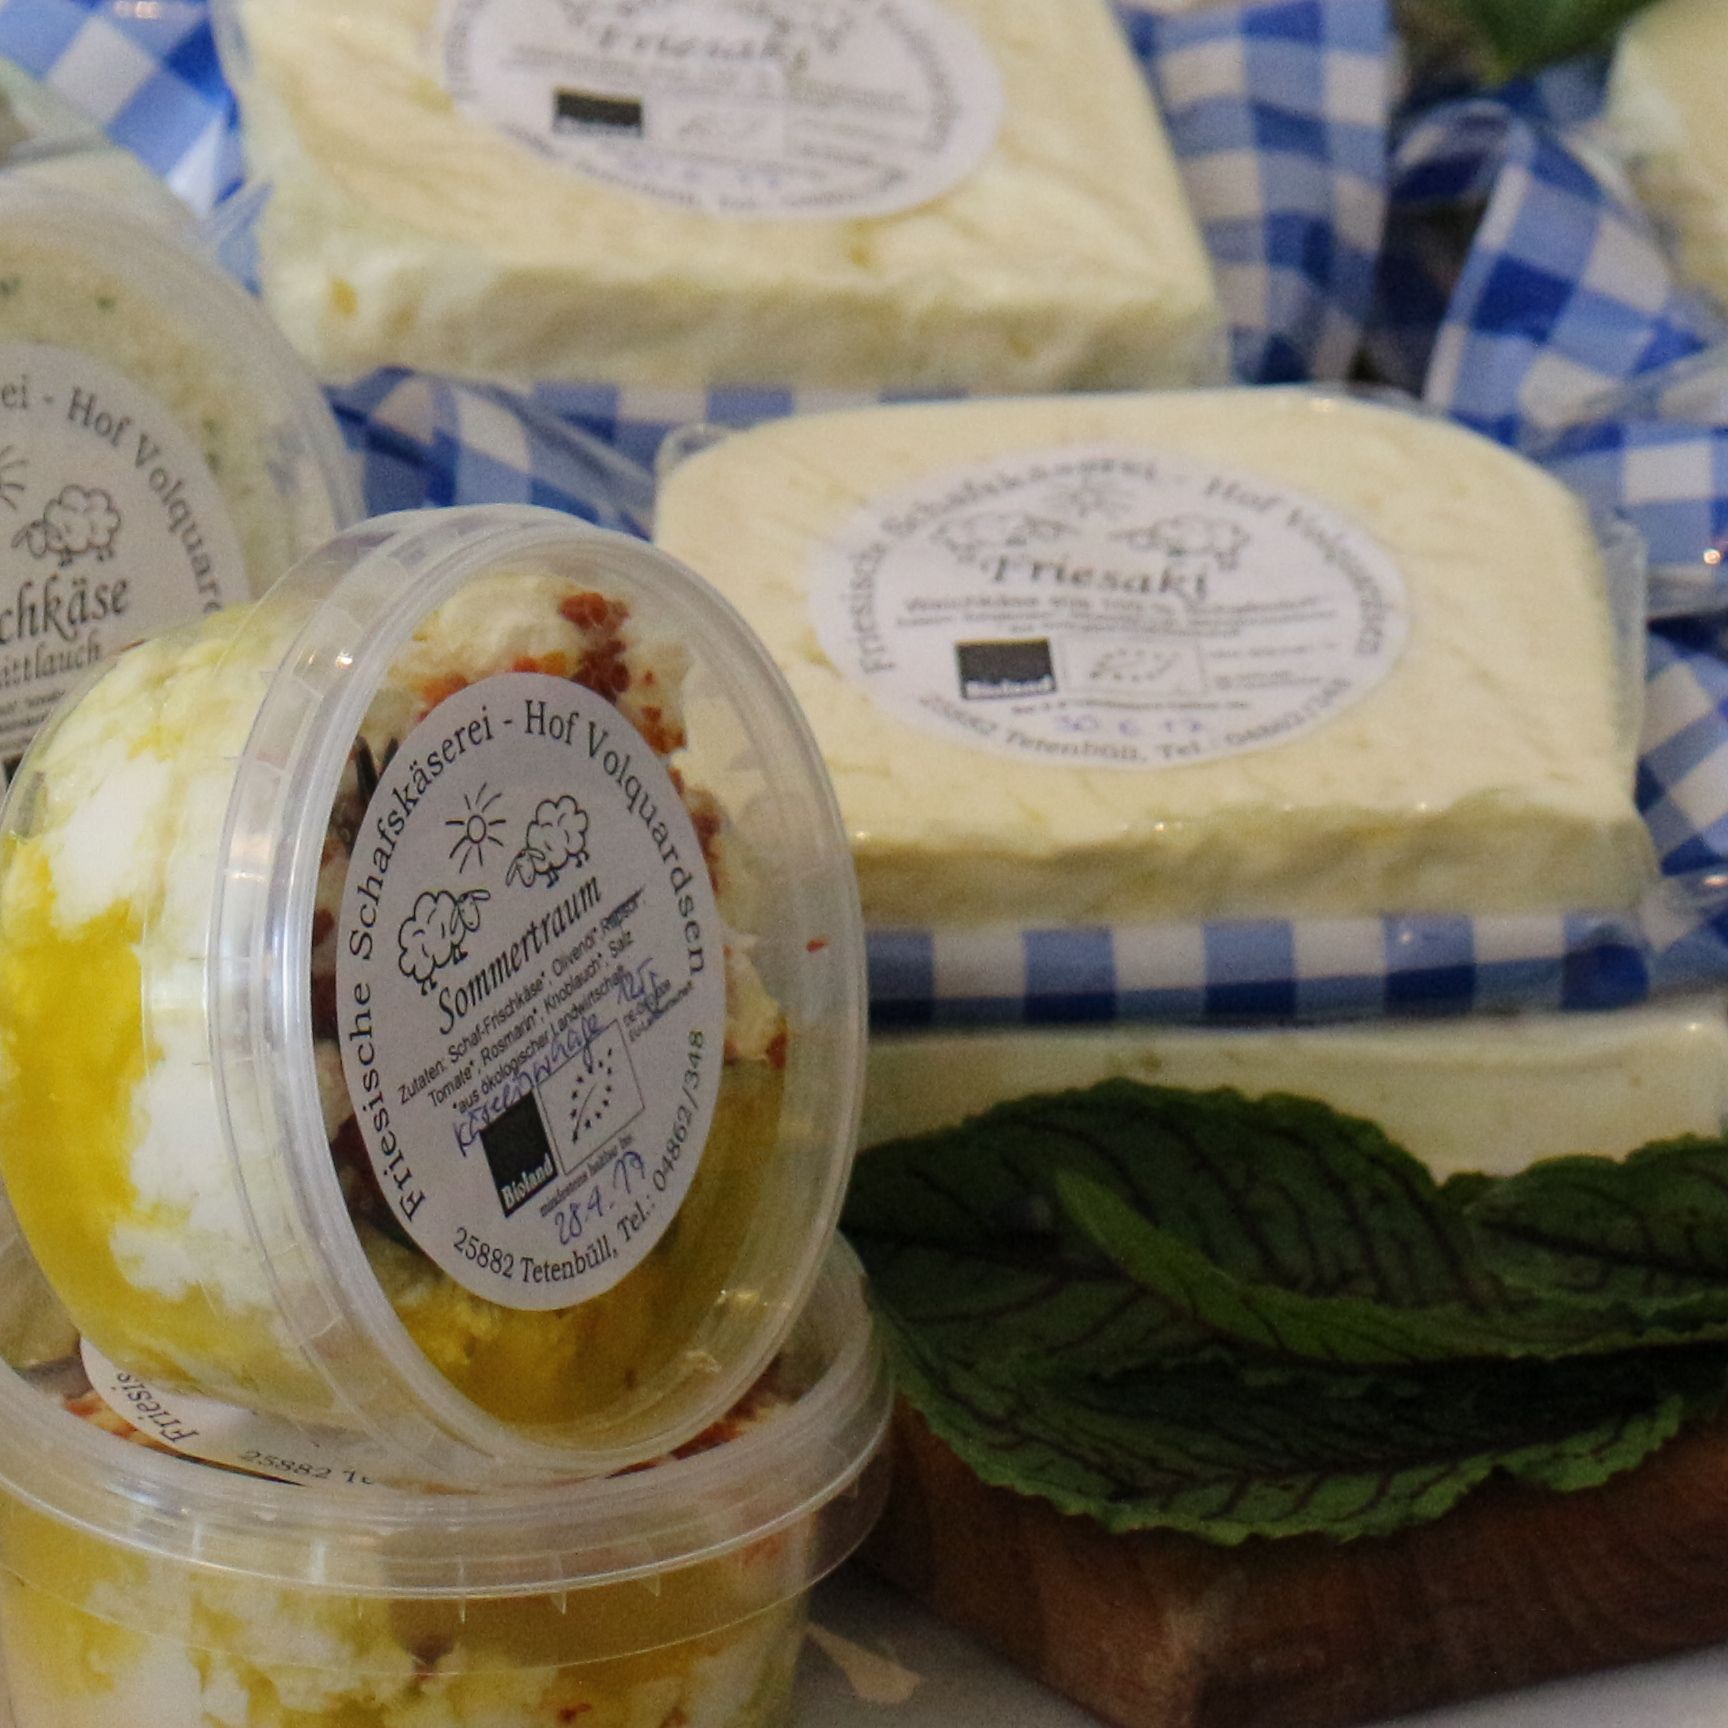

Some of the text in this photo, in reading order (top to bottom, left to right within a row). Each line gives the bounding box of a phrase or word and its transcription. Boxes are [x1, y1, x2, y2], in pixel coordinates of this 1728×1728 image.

[67, 385, 132, 448] Hof
[978, 551, 1210, 602] Friesaki
[524, 699, 580, 744] Hof
[349, 705, 493, 961] Schafskäserei
[588, 721, 705, 976] Volquardsen
[437, 875, 602, 1035] Sommertraum
[480, 1030, 550, 1096] ökologischer
[349, 982, 426, 1222] Friesische
[453, 1225, 514, 1279] 25882
[521, 1234, 618, 1285] Tetenbüll,
[652, 1029, 705, 1193] 04862/348
[500, 1152, 555, 1210] Bioland
[240, 1450, 332, 1480] 25882
